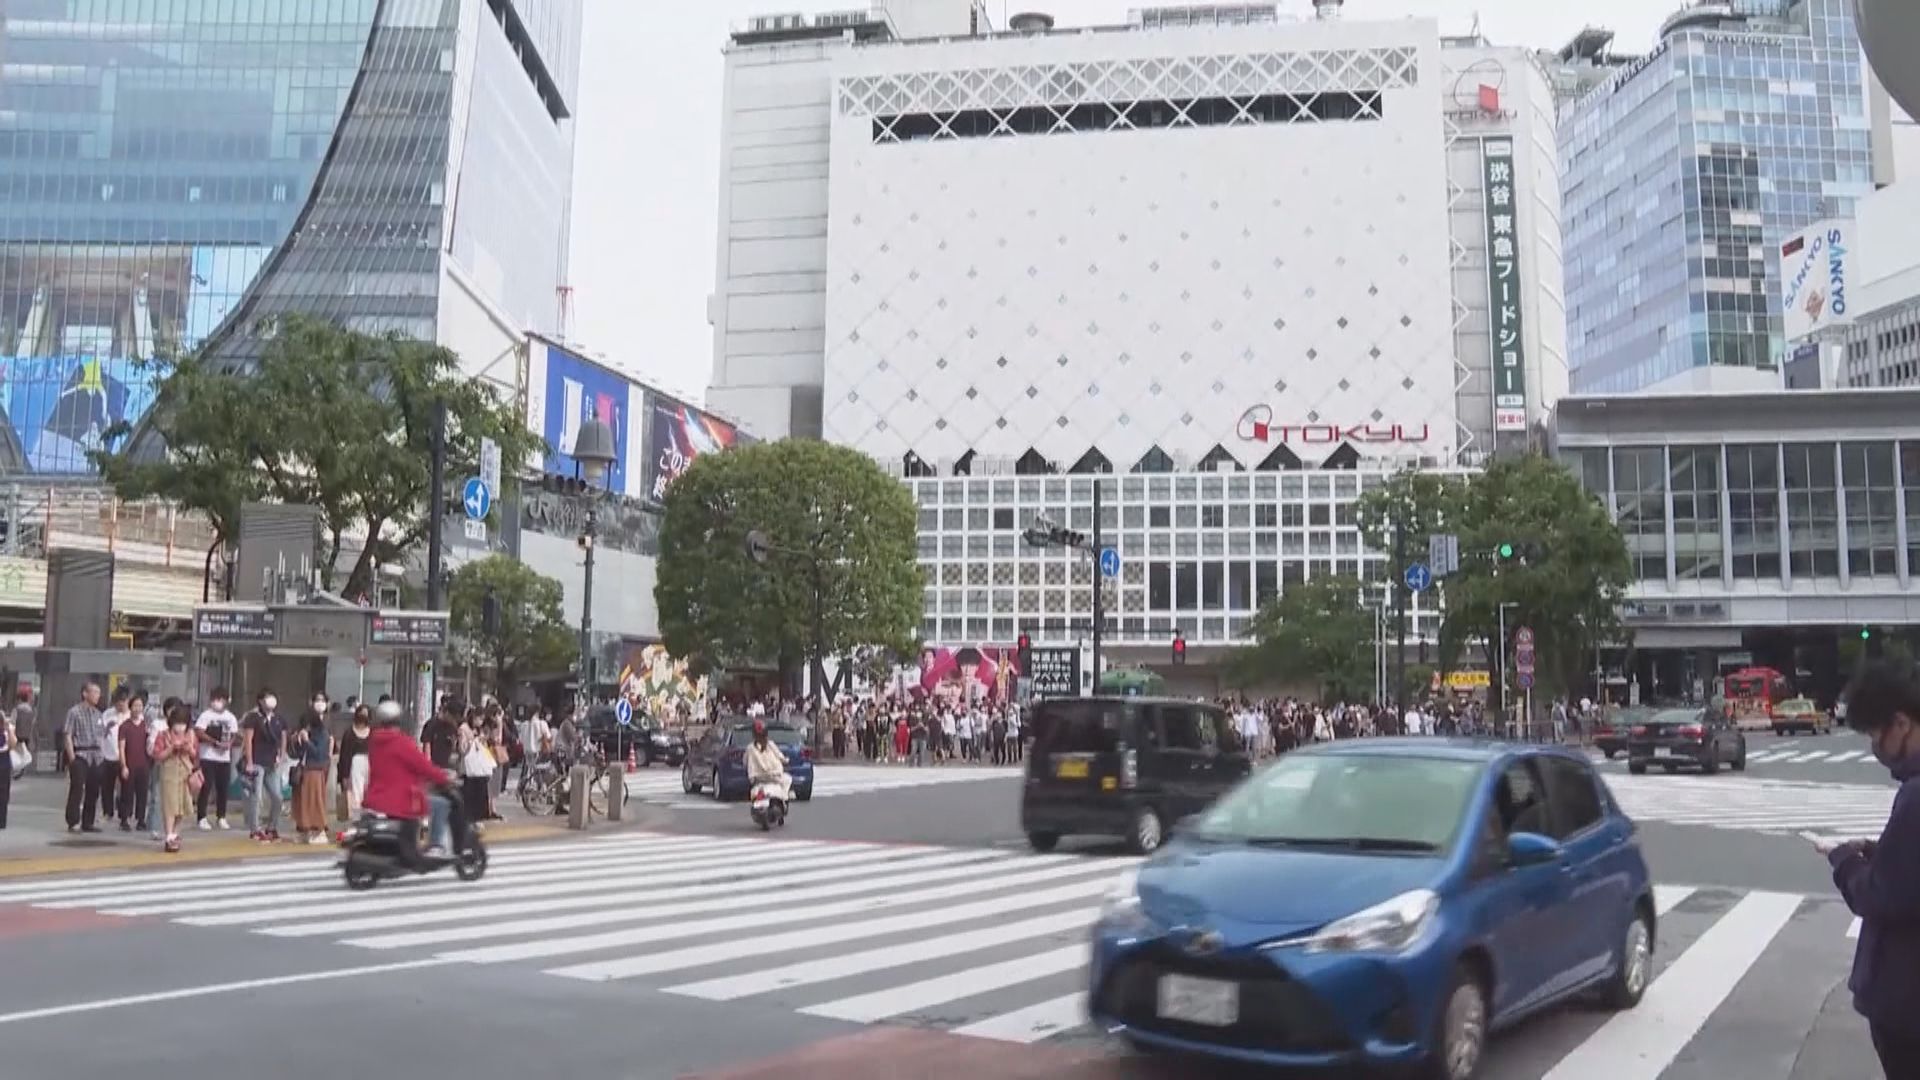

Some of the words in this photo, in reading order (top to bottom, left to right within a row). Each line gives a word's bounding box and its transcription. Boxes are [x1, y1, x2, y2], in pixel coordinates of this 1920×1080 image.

[1489, 161, 1511, 206] 渋谷
[1491, 214, 1518, 391] 東急フードショー
[1784, 236, 1823, 310] SANKYO
[1827, 228, 1849, 316] SANKYO
[1269, 423, 1429, 443] TOKYU
